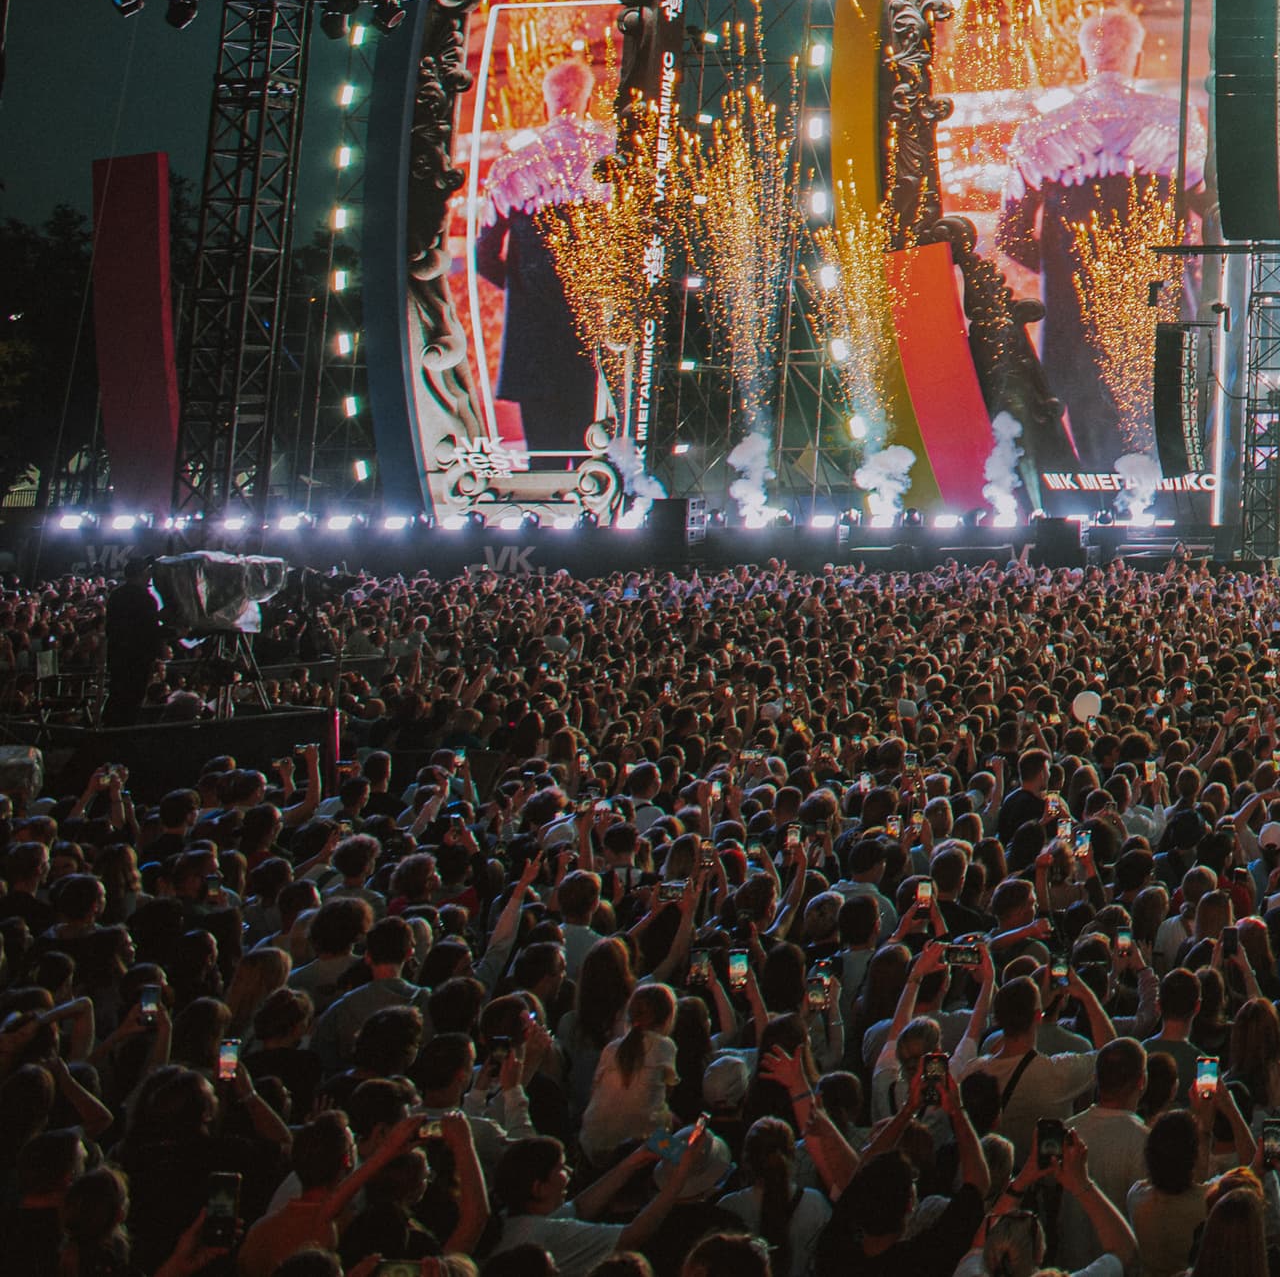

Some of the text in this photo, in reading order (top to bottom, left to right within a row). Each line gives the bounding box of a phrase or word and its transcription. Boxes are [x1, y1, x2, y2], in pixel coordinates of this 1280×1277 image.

[636, 319, 656, 442] МЕГАМИКС
[460, 437, 505, 453] VK
[450, 447, 529, 469] fest
[484, 546, 536, 571] VK
